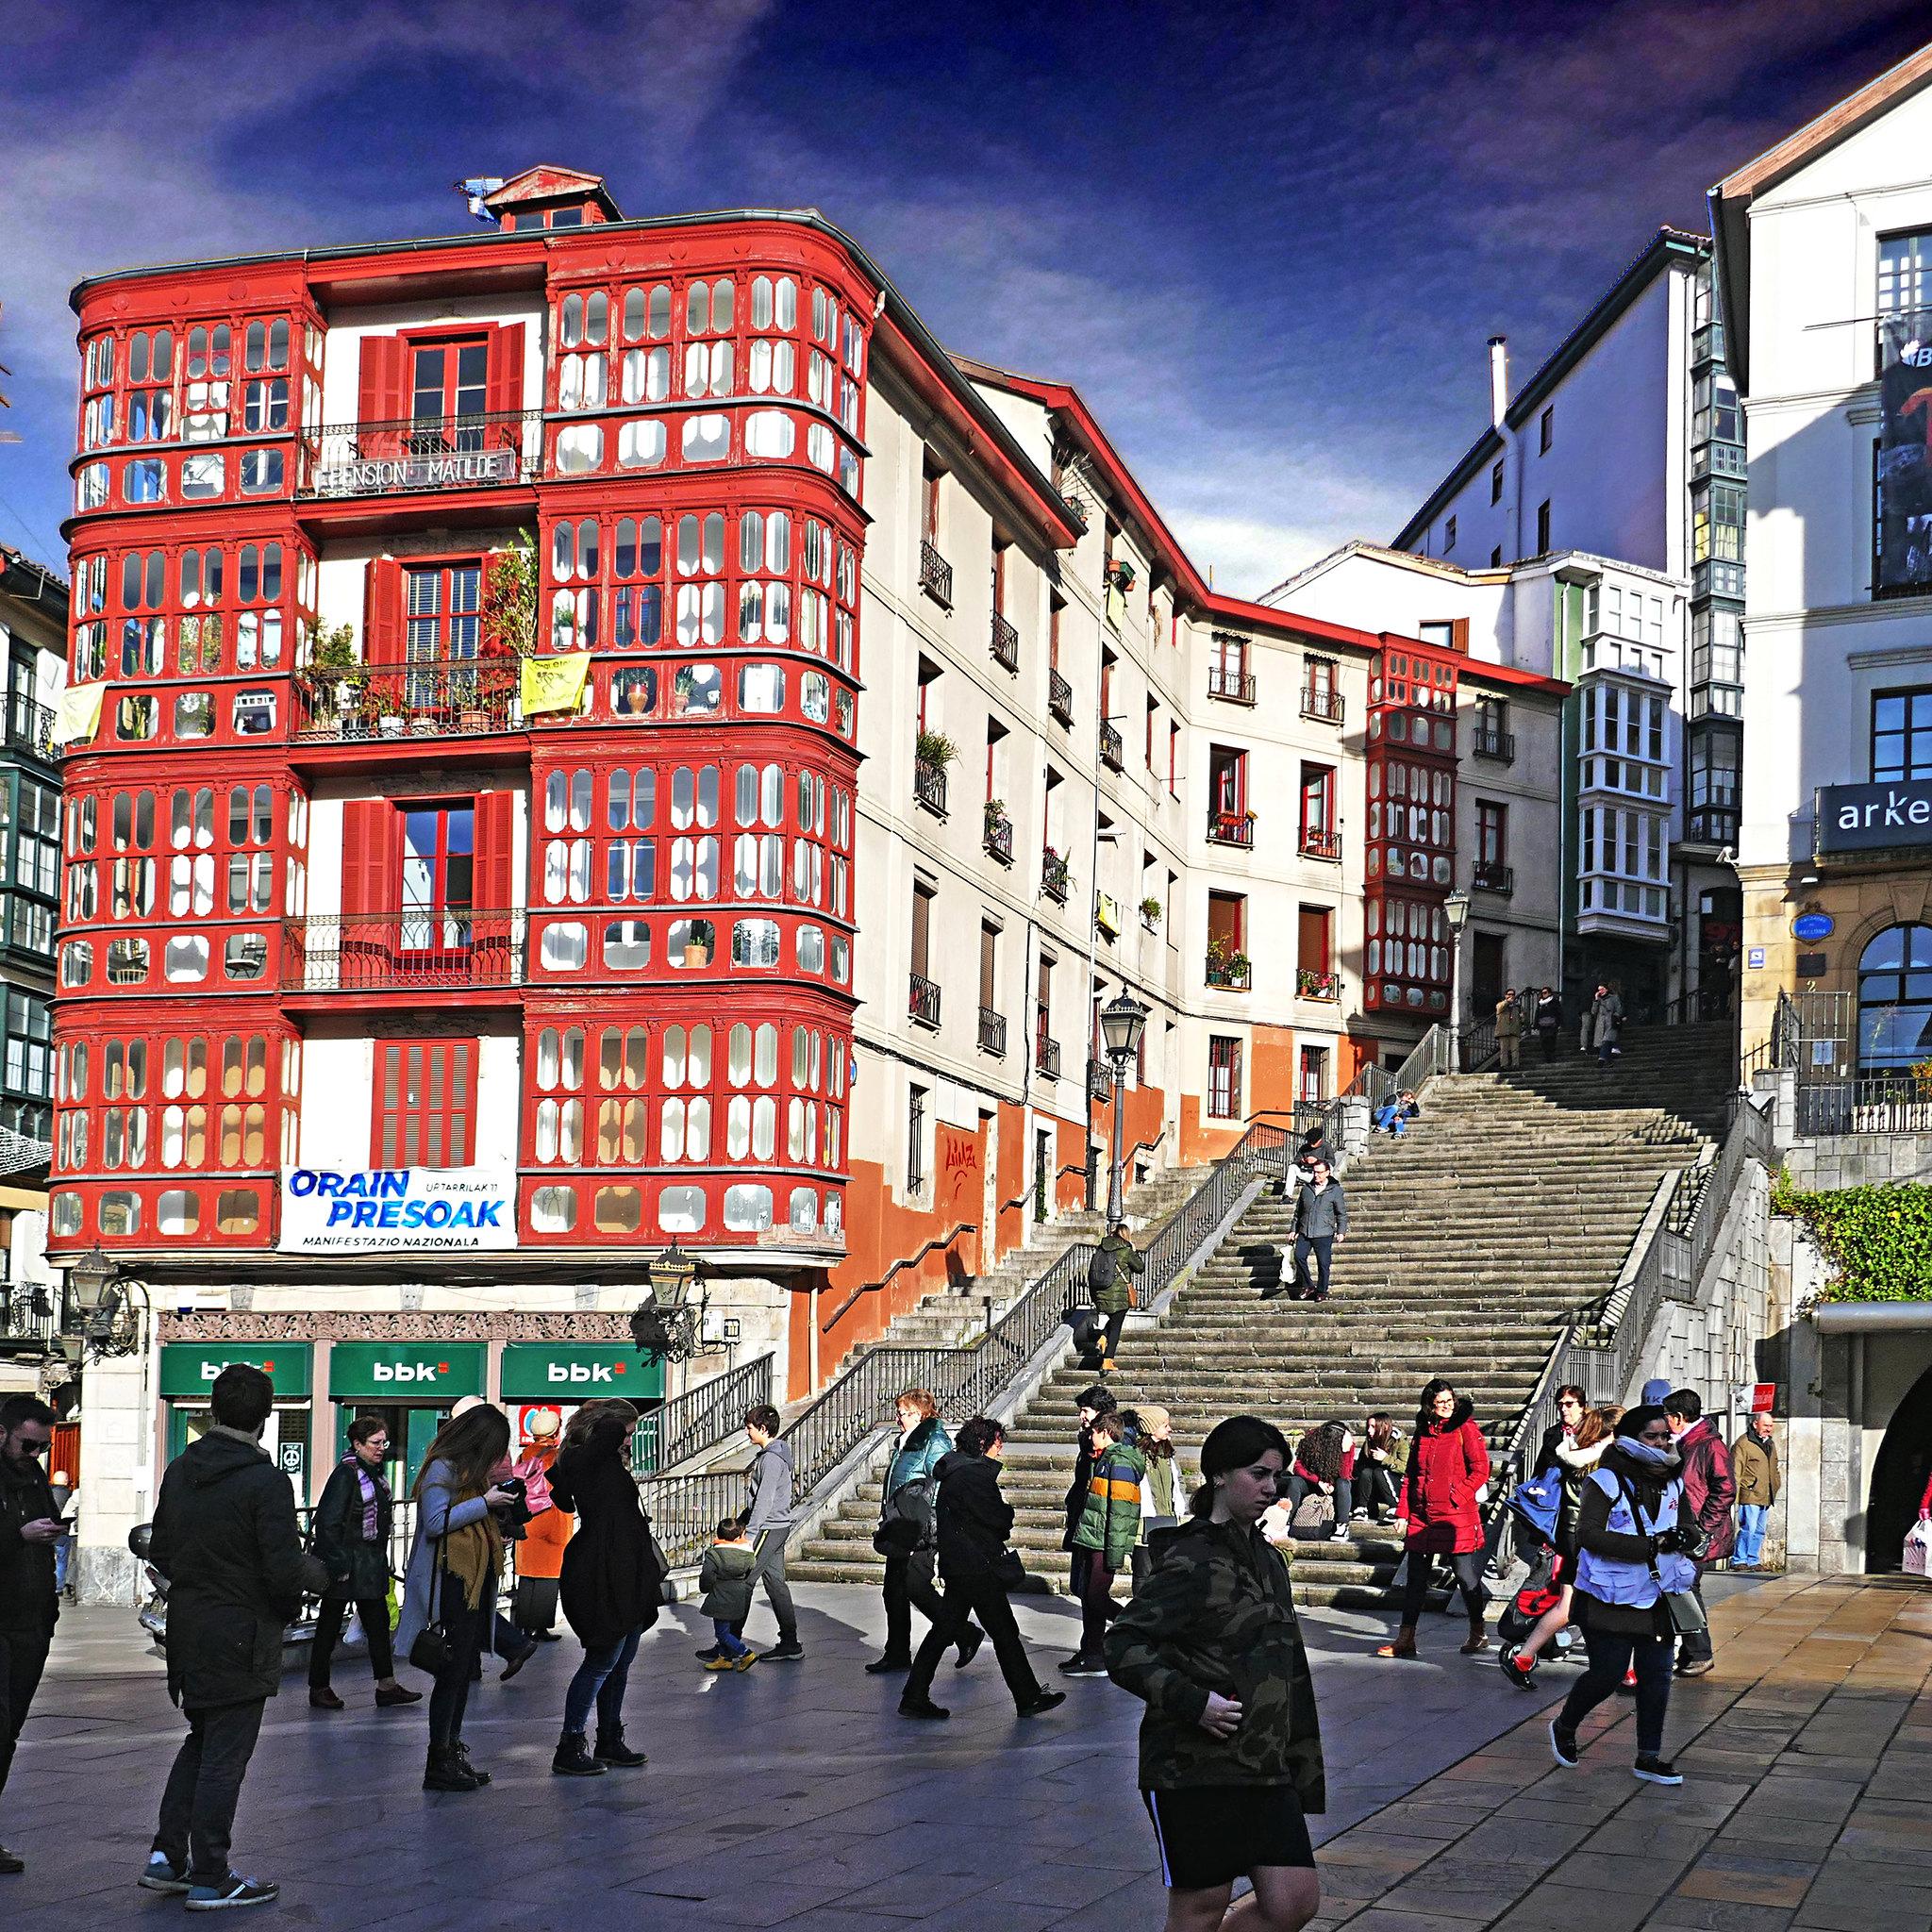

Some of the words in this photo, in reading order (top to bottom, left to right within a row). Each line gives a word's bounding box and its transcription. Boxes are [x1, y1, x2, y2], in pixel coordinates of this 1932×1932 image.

[329, 460, 408, 489] PENSION
[428, 456, 498, 482] MATILDE
[1807, 980, 1816, 992] 2
[289, 1170, 409, 1198] ORAIN
[326, 1200, 506, 1228] PRESOAK
[302, 1236, 402, 1247] MANIFESTAZIO
[403, 1236, 479, 1247] NAZIONALA
[373, 1362, 437, 1382] bbk
[547, 1362, 613, 1383] bbk
